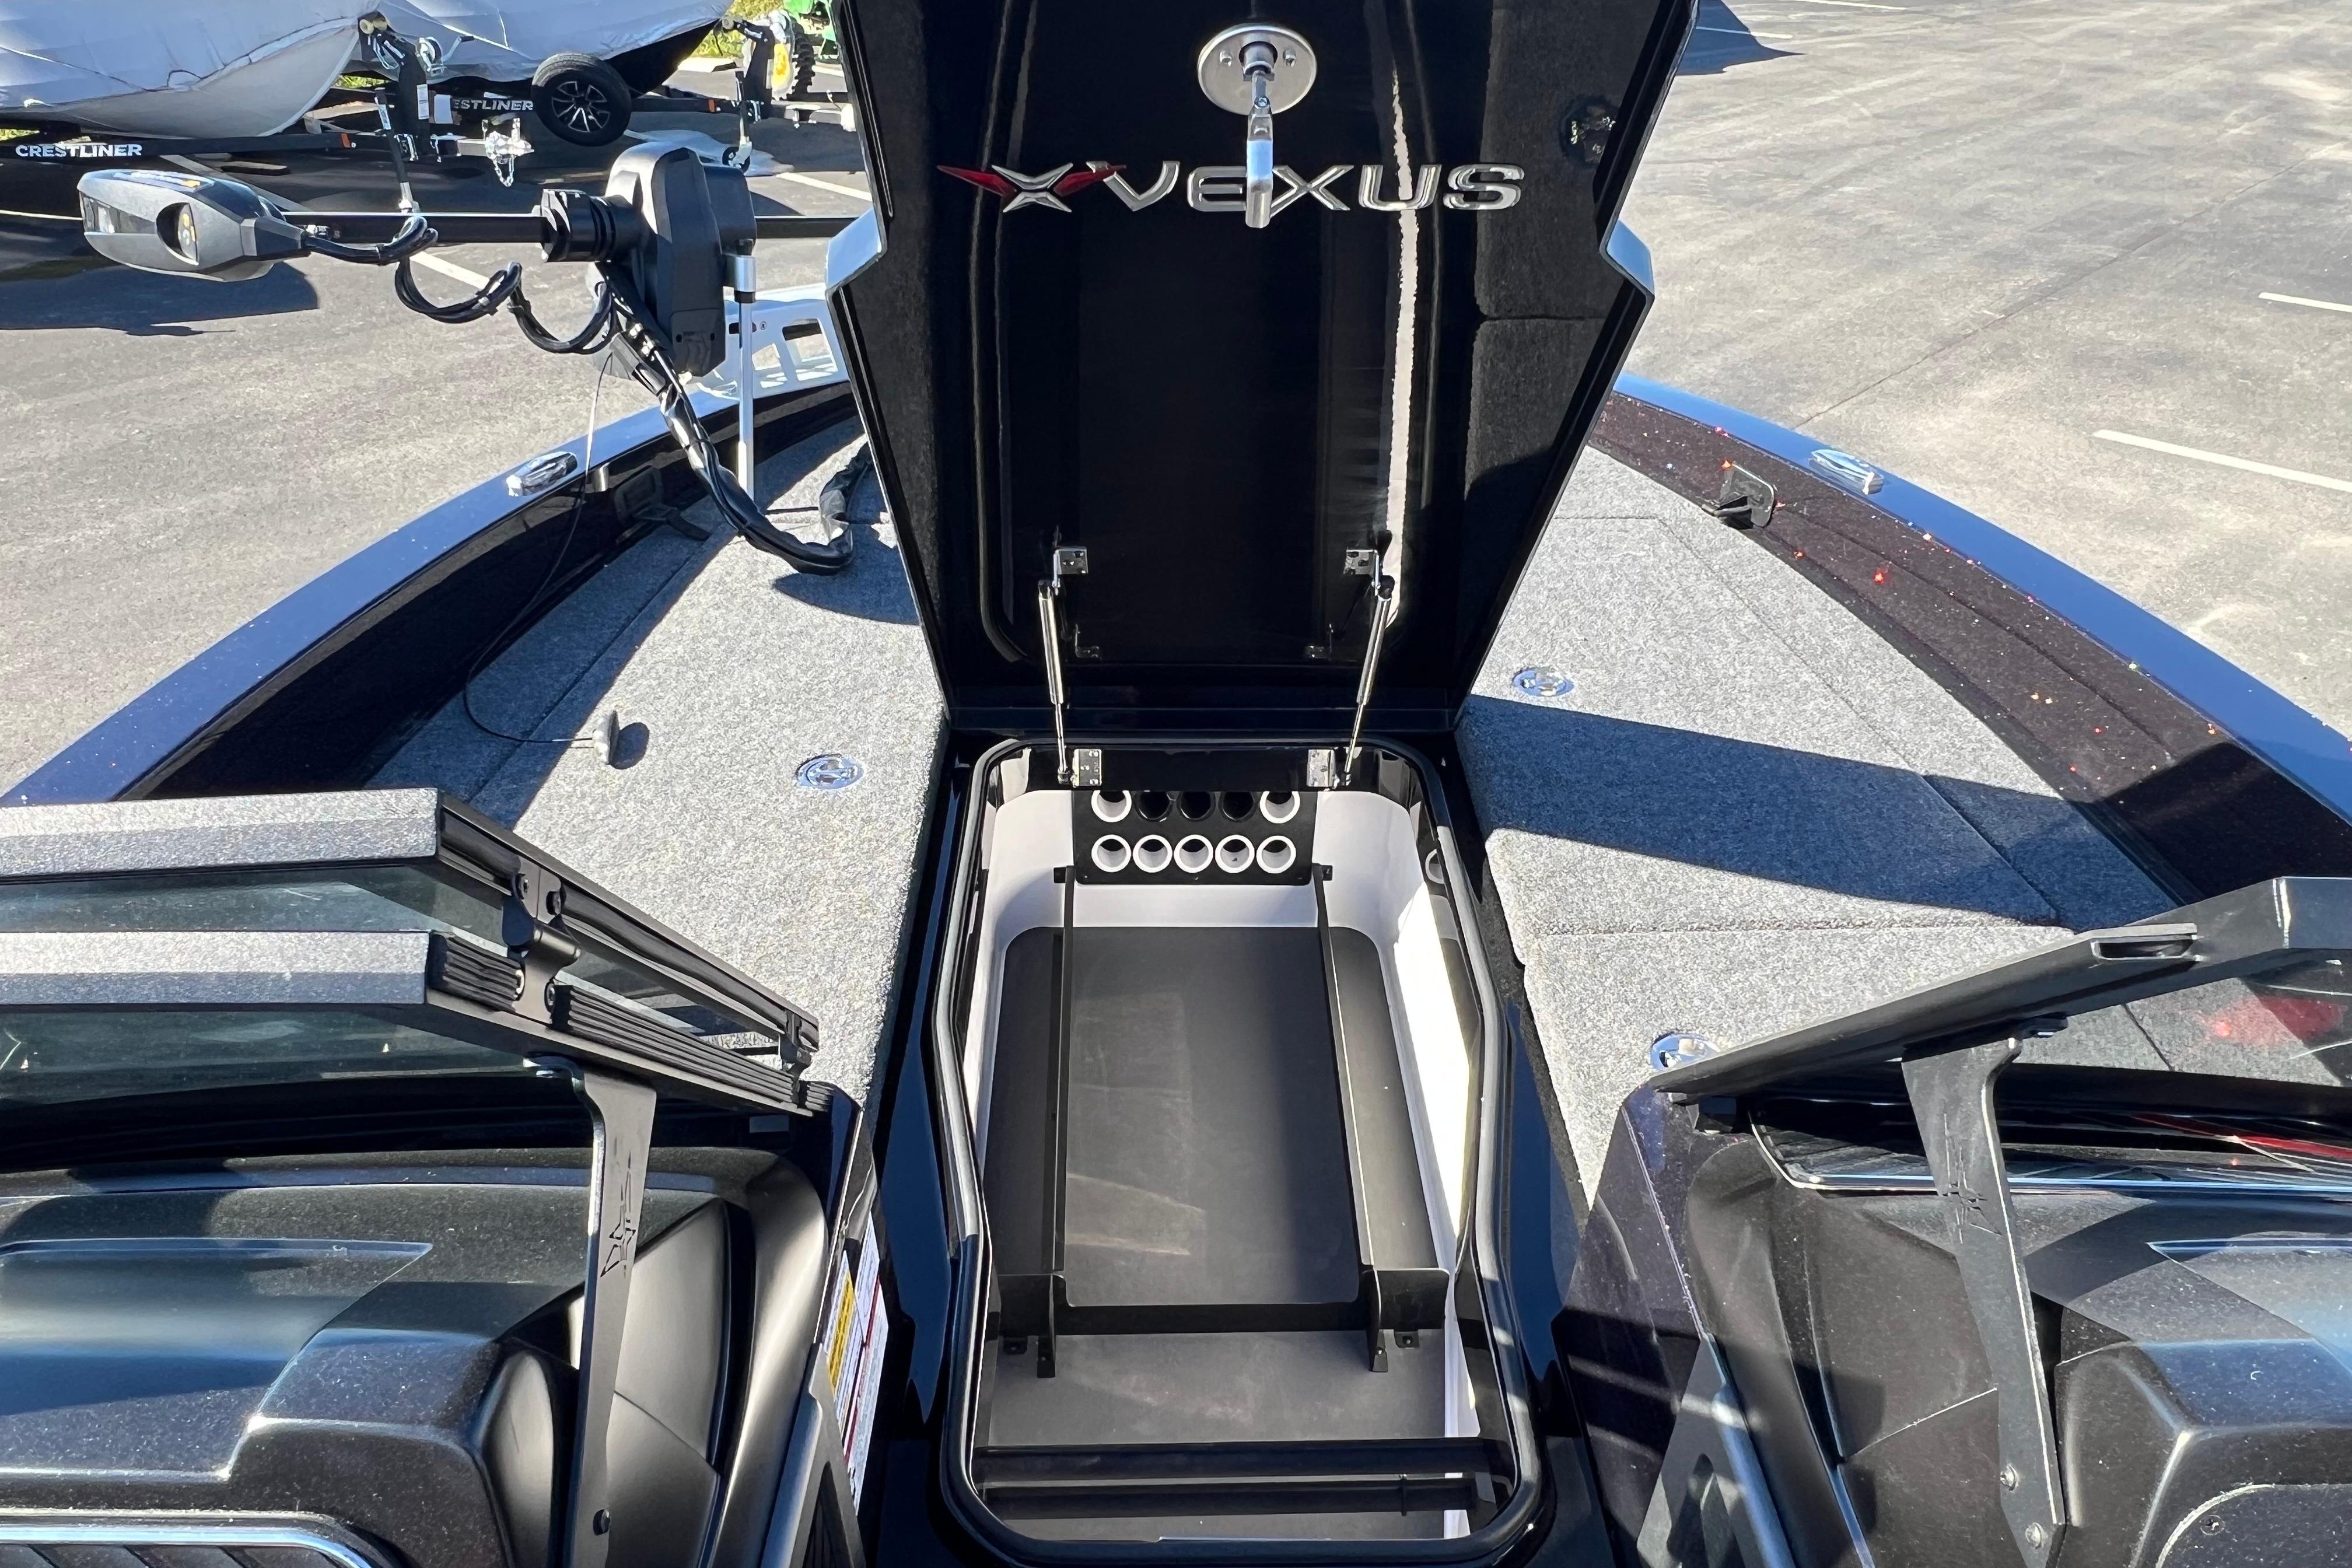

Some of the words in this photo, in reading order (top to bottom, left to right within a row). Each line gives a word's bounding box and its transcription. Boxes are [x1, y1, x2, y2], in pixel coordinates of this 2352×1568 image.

[453, 99, 534, 110] ESTLINER
[15, 144, 142, 157] CRESTLINER
[1086, 160, 1525, 218] VEXUS
